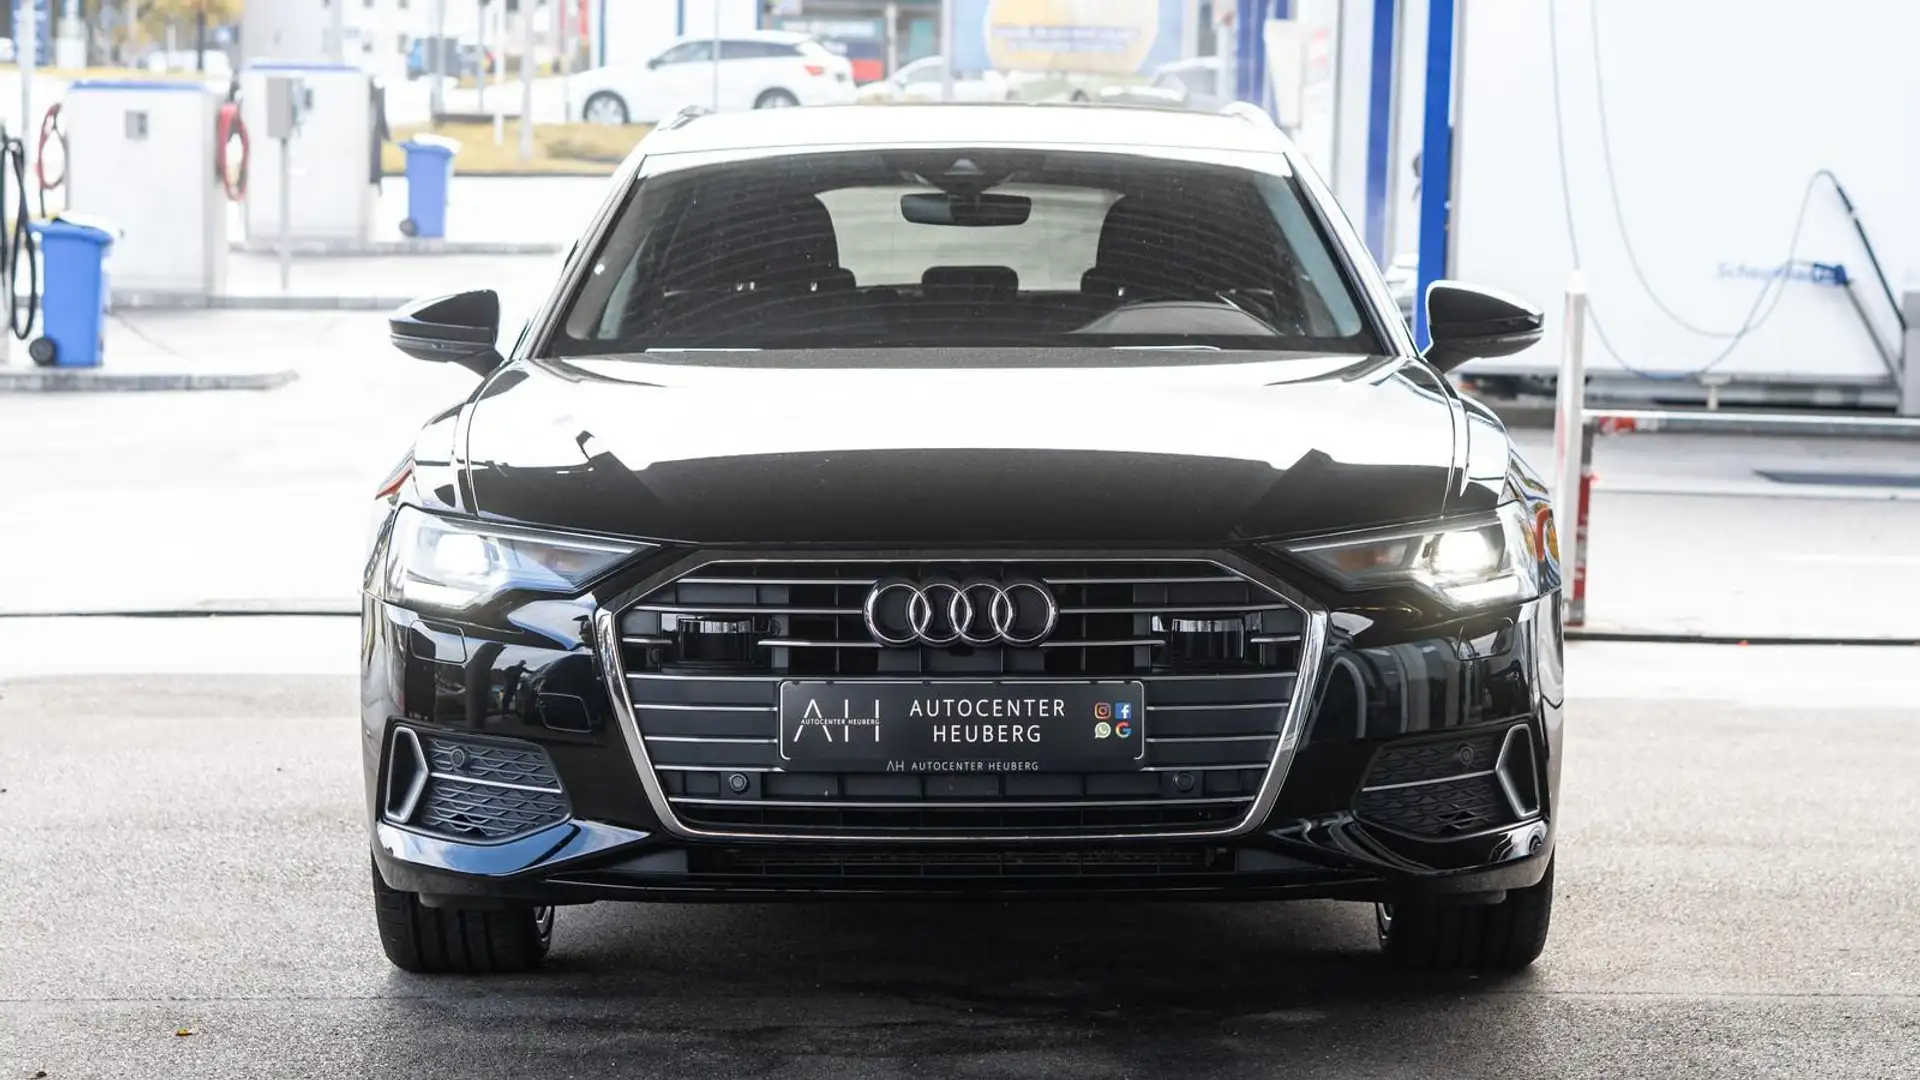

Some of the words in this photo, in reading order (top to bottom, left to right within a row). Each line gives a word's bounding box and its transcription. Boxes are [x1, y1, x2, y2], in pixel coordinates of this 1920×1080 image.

[909, 699, 1065, 717] AUTOCENTER
[793, 698, 880, 742] AH
[933, 724, 1041, 743] HEUBERG
[886, 760, 905, 772] AH
[911, 761, 984, 772] AUTOCENTER
[988, 761, 1039, 772] HEUBERG
